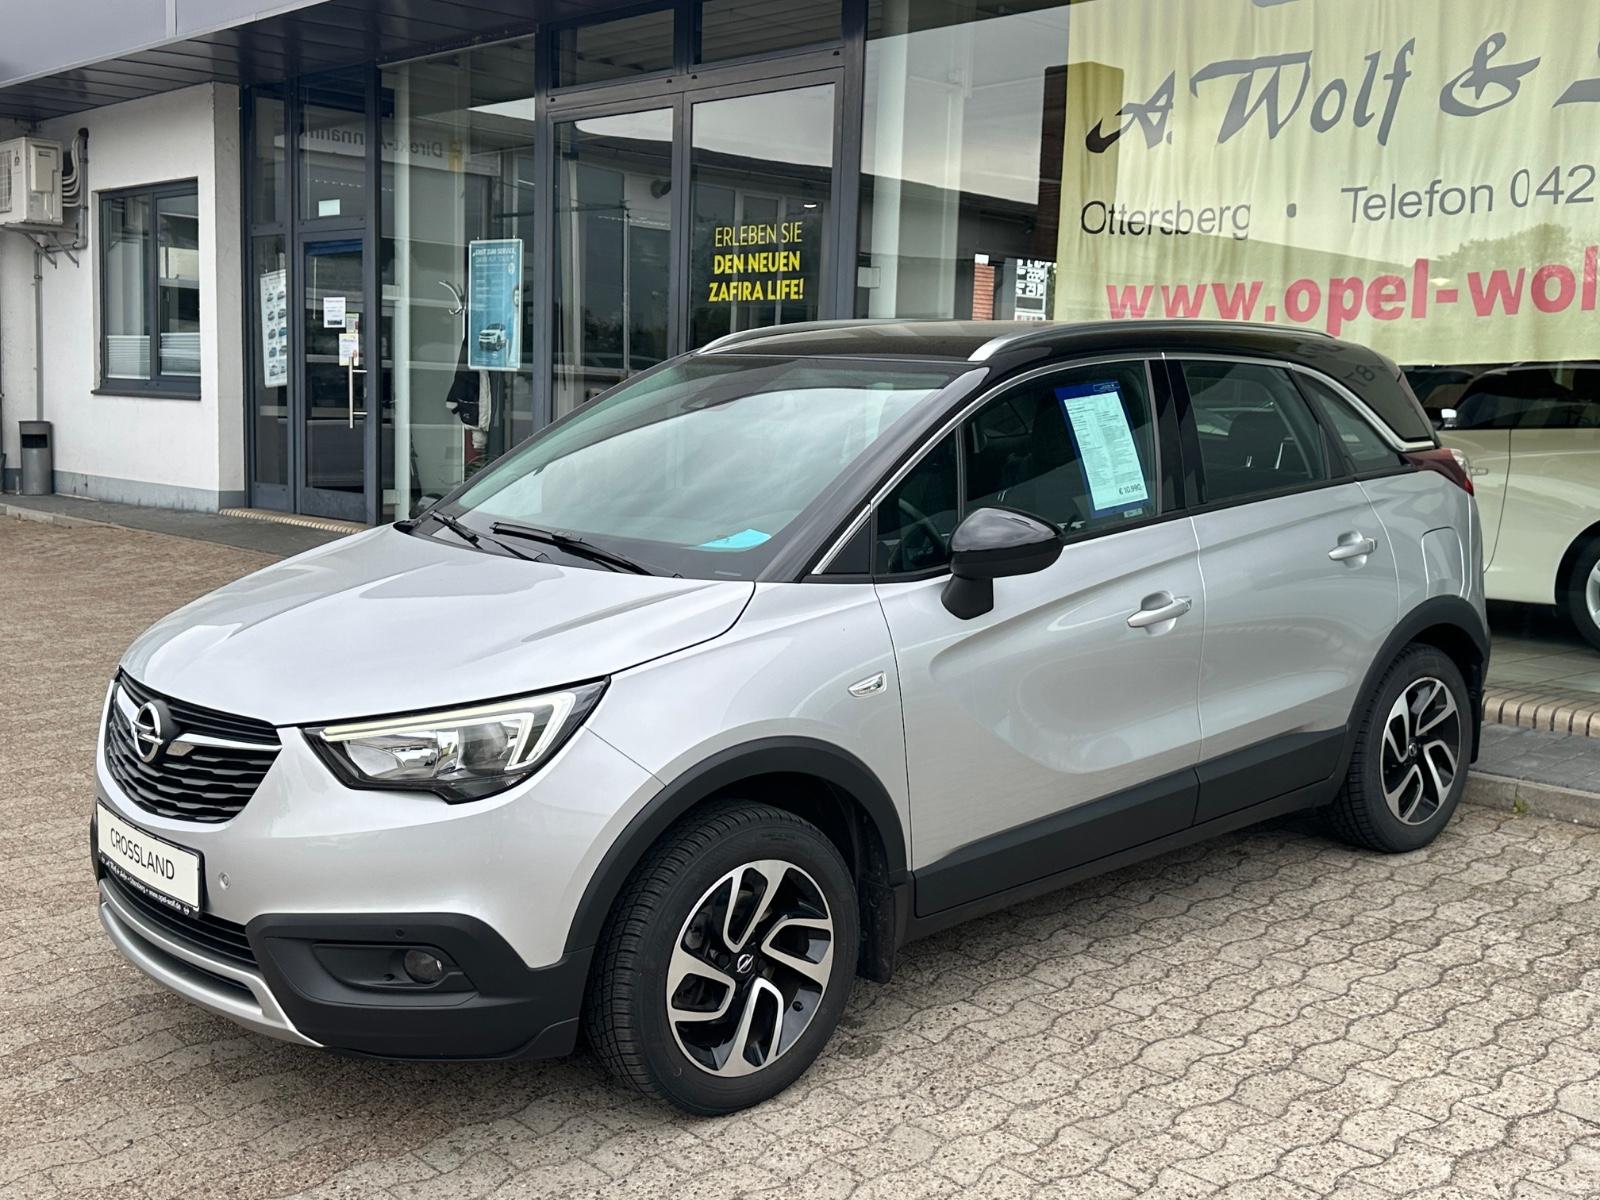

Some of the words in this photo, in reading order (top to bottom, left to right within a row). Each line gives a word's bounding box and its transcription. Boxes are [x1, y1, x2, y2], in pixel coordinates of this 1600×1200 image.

[1189, 37, 1416, 147] Wolf
[1439, 31, 1542, 117] &
[1340, 179, 1494, 224] Telefon
[1509, 164, 1597, 209] 042
[715, 224, 777, 248] ERLEBEN
[780, 221, 804, 243] SIE
[1081, 200, 1251, 241] Ottersberg
[713, 253, 745, 275] DEN
[747, 250, 801, 273] NEUEN
[708, 281, 764, 302] ZAFIRA
[767, 277, 805, 301] LIFE!
[110, 827, 175, 881] CROSSLAND
